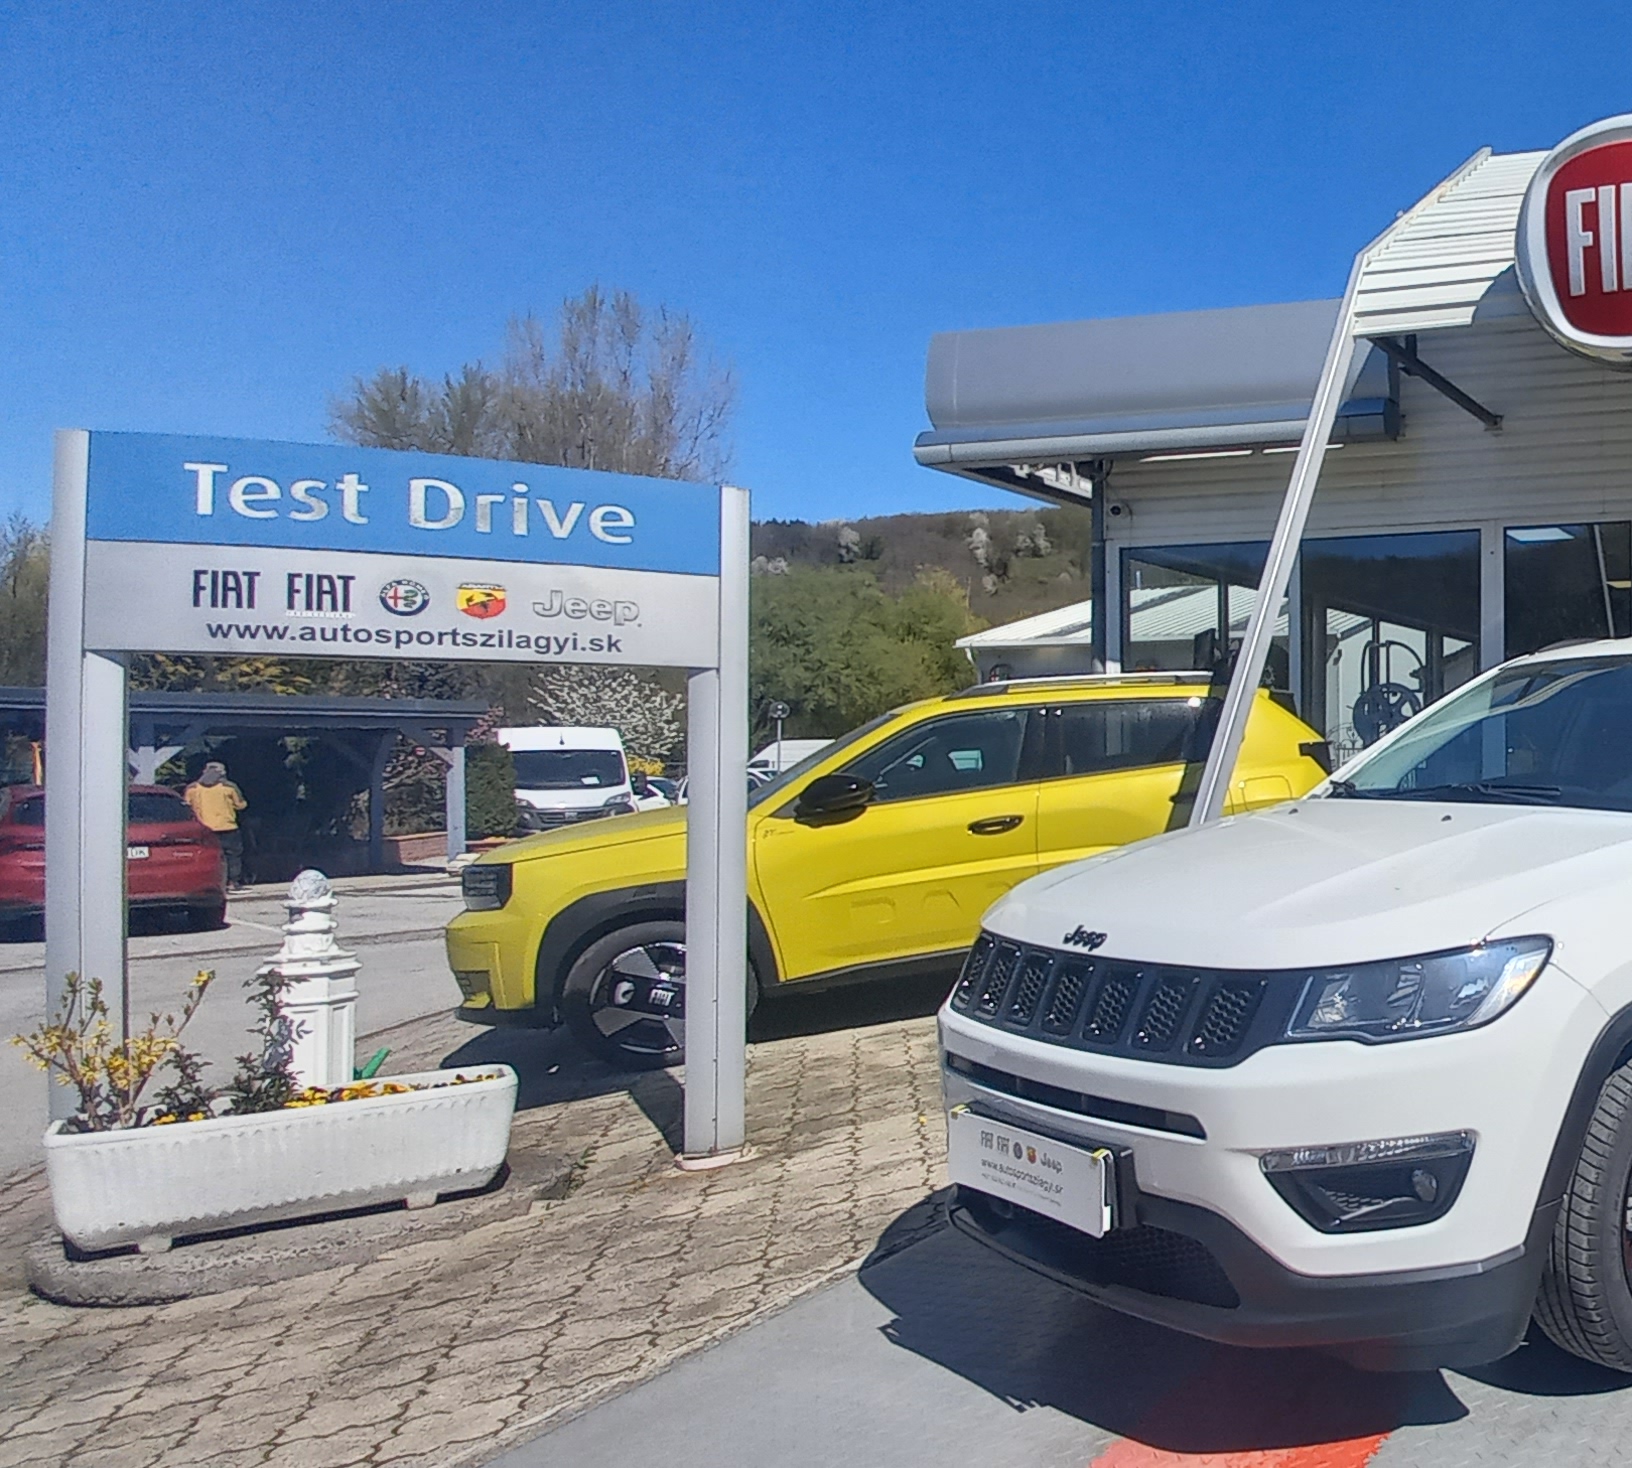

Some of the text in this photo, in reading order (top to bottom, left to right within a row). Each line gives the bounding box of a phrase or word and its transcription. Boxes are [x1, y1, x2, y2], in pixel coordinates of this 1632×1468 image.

[183, 462, 636, 545] Test Drive
[193, 569, 261, 609] FIAT
[286, 572, 357, 613] FIAT
[532, 589, 641, 627] Jeep
[206, 622, 622, 655] www.autosportszilagyi.sk
[1061, 924, 1108, 952] Jeep
